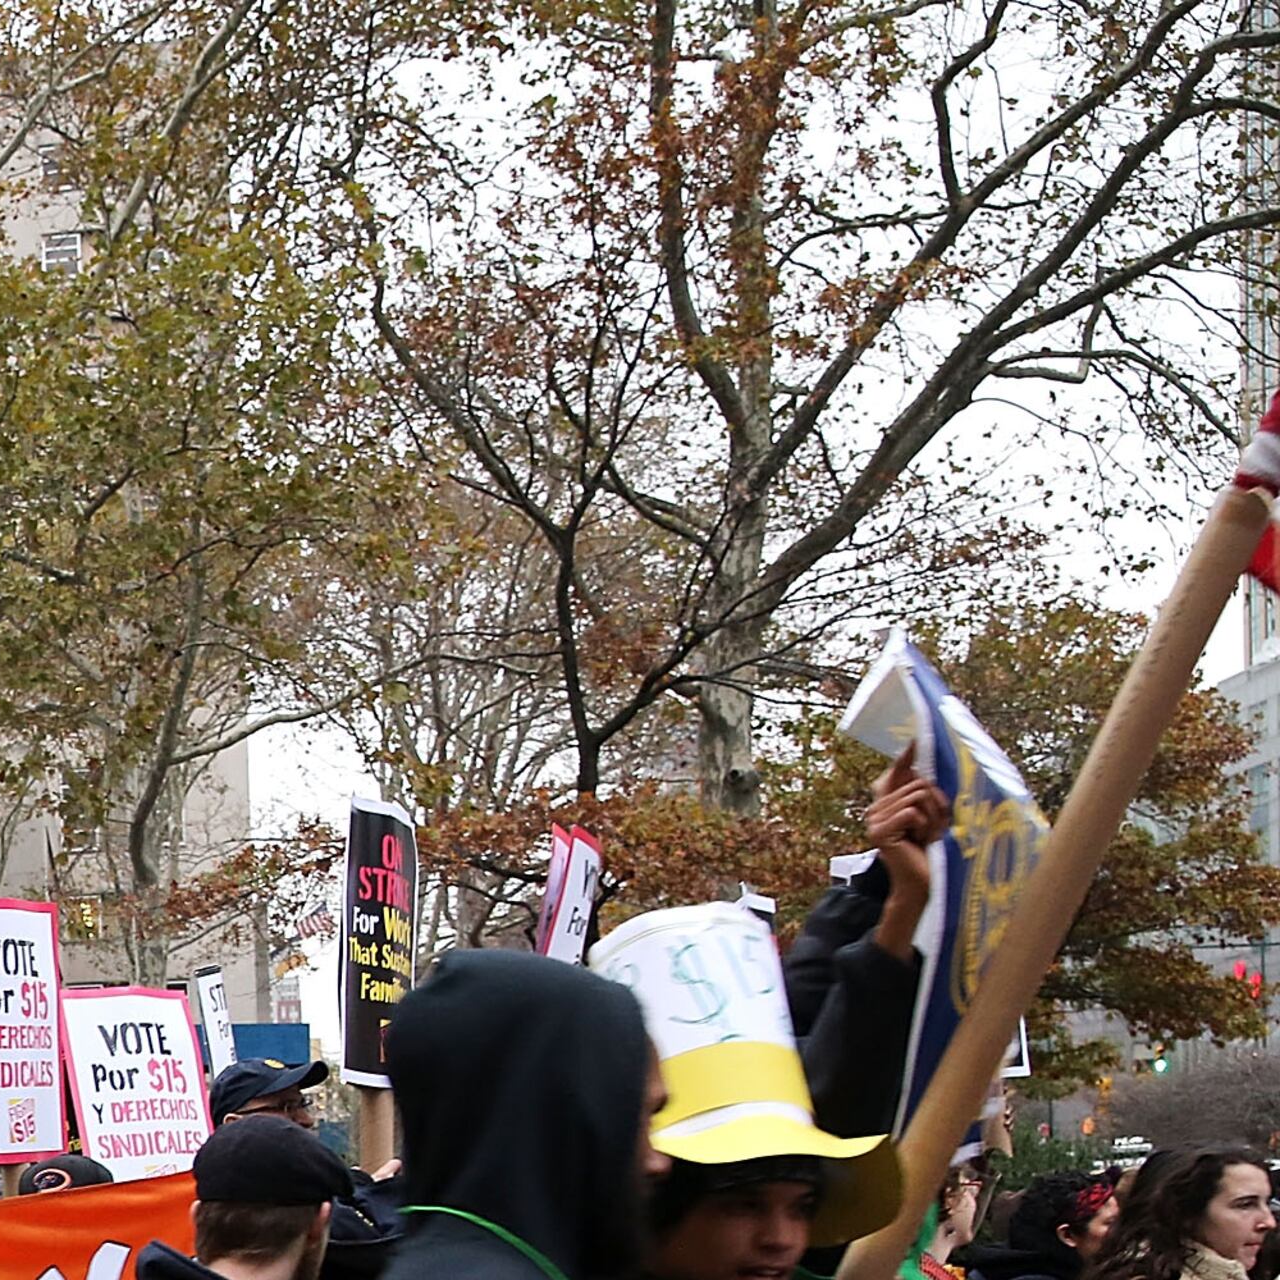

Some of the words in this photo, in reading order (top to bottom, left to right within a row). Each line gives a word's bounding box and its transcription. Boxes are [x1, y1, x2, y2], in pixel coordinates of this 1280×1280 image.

[382, 834, 402, 870] ON
[353, 906, 379, 935] For
[349, 937, 378, 967] That
[21, 981, 47, 1020] $15
[98, 1022, 172, 1057] VOTE
[91, 1064, 139, 1093] Por
[147, 1058, 187, 1095] $15
[92, 1103, 103, 1124] Y
[111, 1098, 198, 1124] DERECHOS
[98, 1130, 204, 1159] SINDICALES
